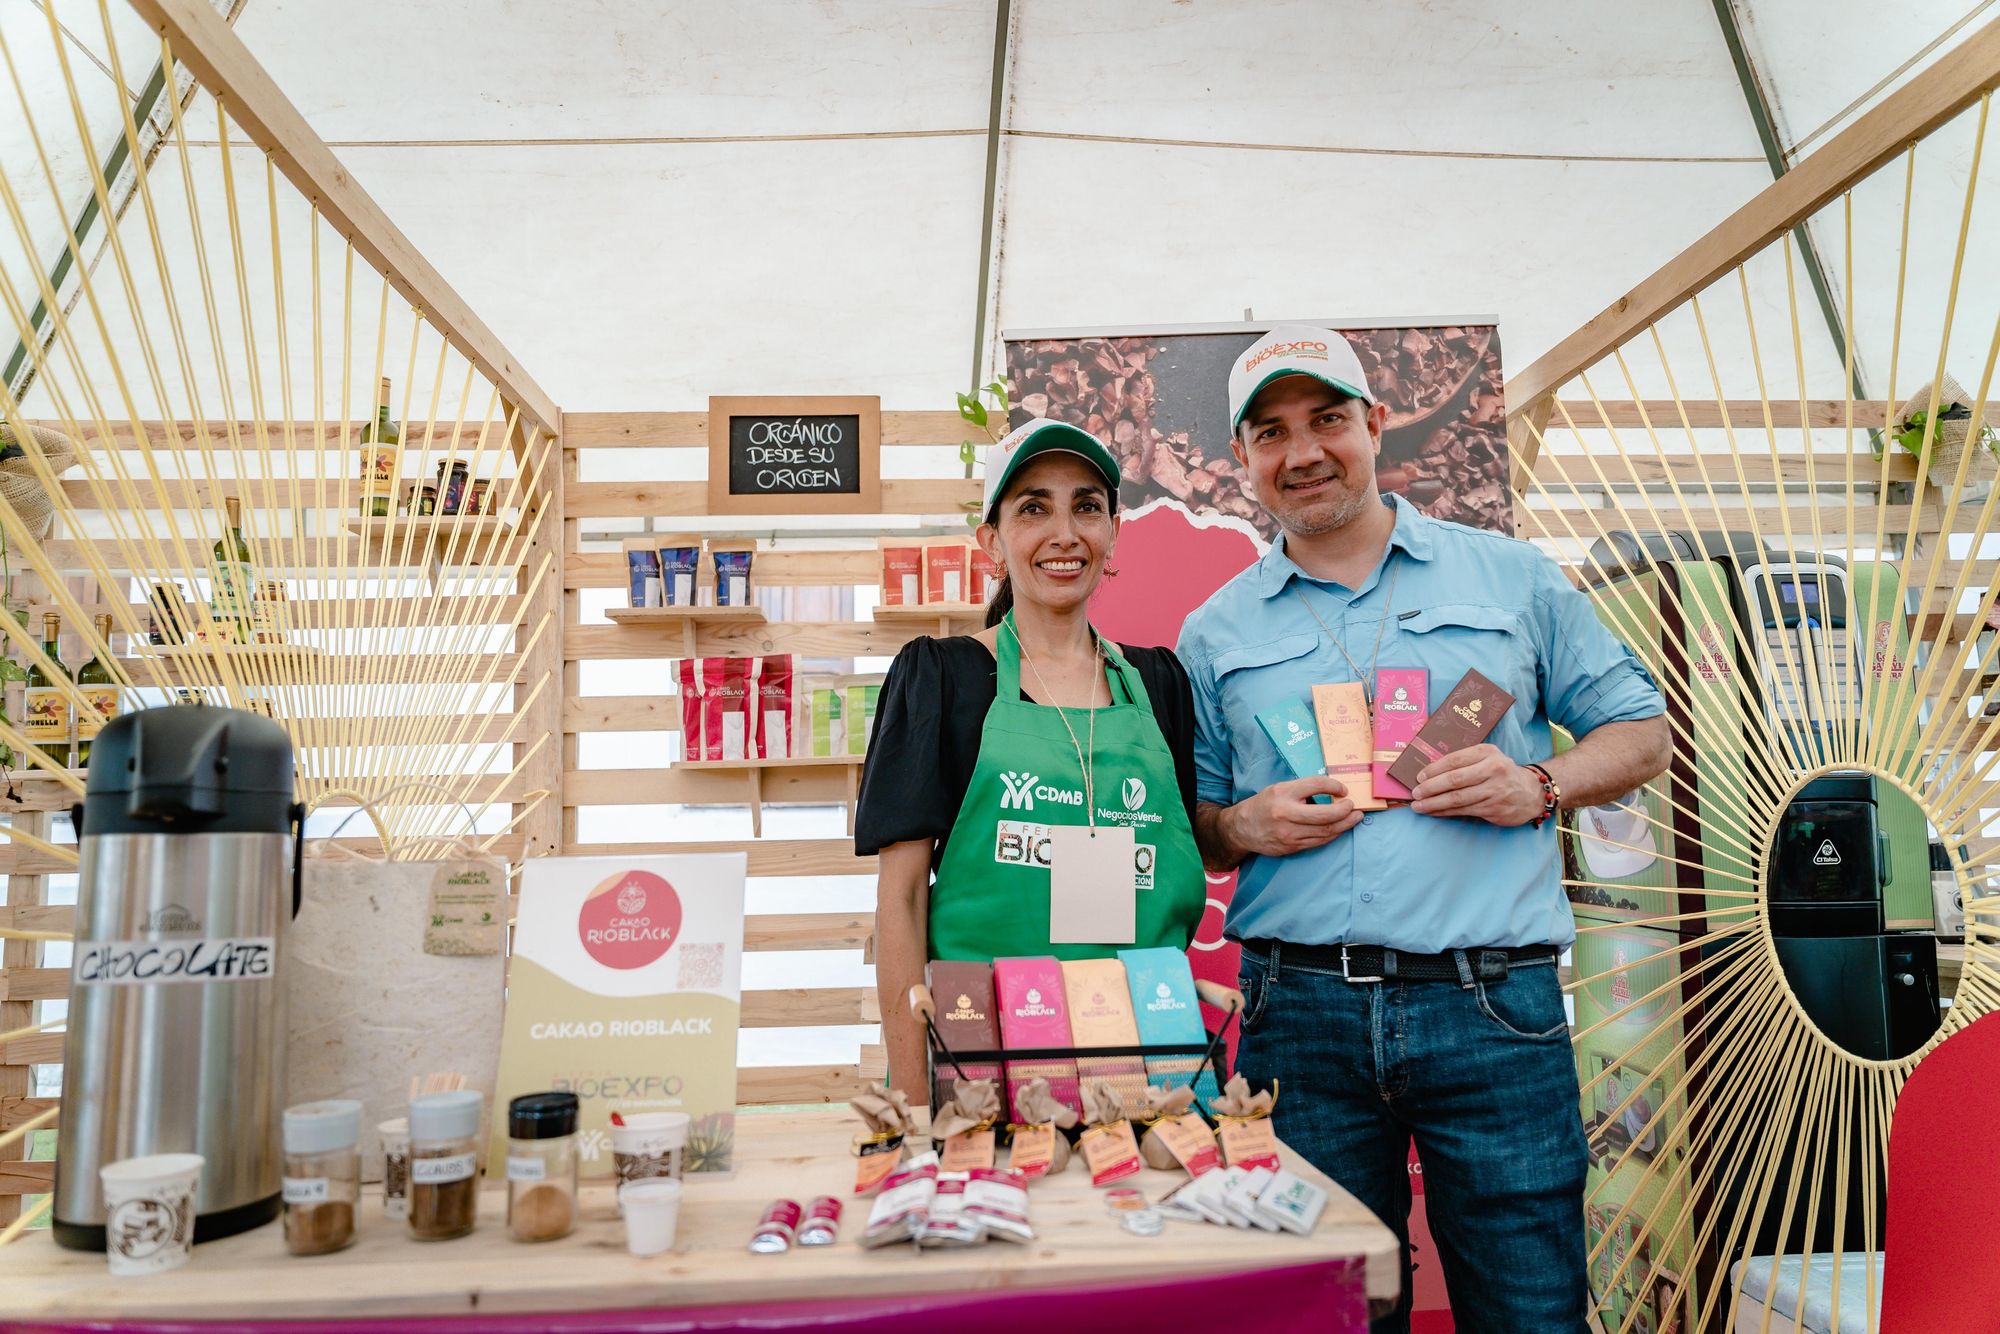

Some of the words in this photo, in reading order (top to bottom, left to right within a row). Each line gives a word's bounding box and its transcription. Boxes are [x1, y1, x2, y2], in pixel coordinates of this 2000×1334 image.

[1246, 341, 1328, 372] BIOEXPO
[749, 418, 843, 449] ORGÁNICO
[746, 446, 807, 465] DESDE
[808, 447, 835, 464] SU
[756, 467, 841, 489] ORIGEN
[1384, 704, 1418, 712] RIOBLACK
[1452, 704, 1482, 728] RIOBLACK
[1035, 785, 1084, 806] CDMB
[1097, 807, 1163, 823] NegociosVerdes
[1001, 823, 1008, 832] X
[609, 916, 651, 928] CAKAO
[586, 926, 671, 945] RIOBLACK
[80, 942, 268, 981] CHOCOLATE
[945, 1012, 985, 1021] RIOBLACK
[1015, 1008, 1056, 1018] RIOBLACK
[530, 1021, 603, 1040] CAKAO
[608, 1017, 712, 1037] RIOBLACK
[551, 1075, 684, 1099] BIOEXPO
